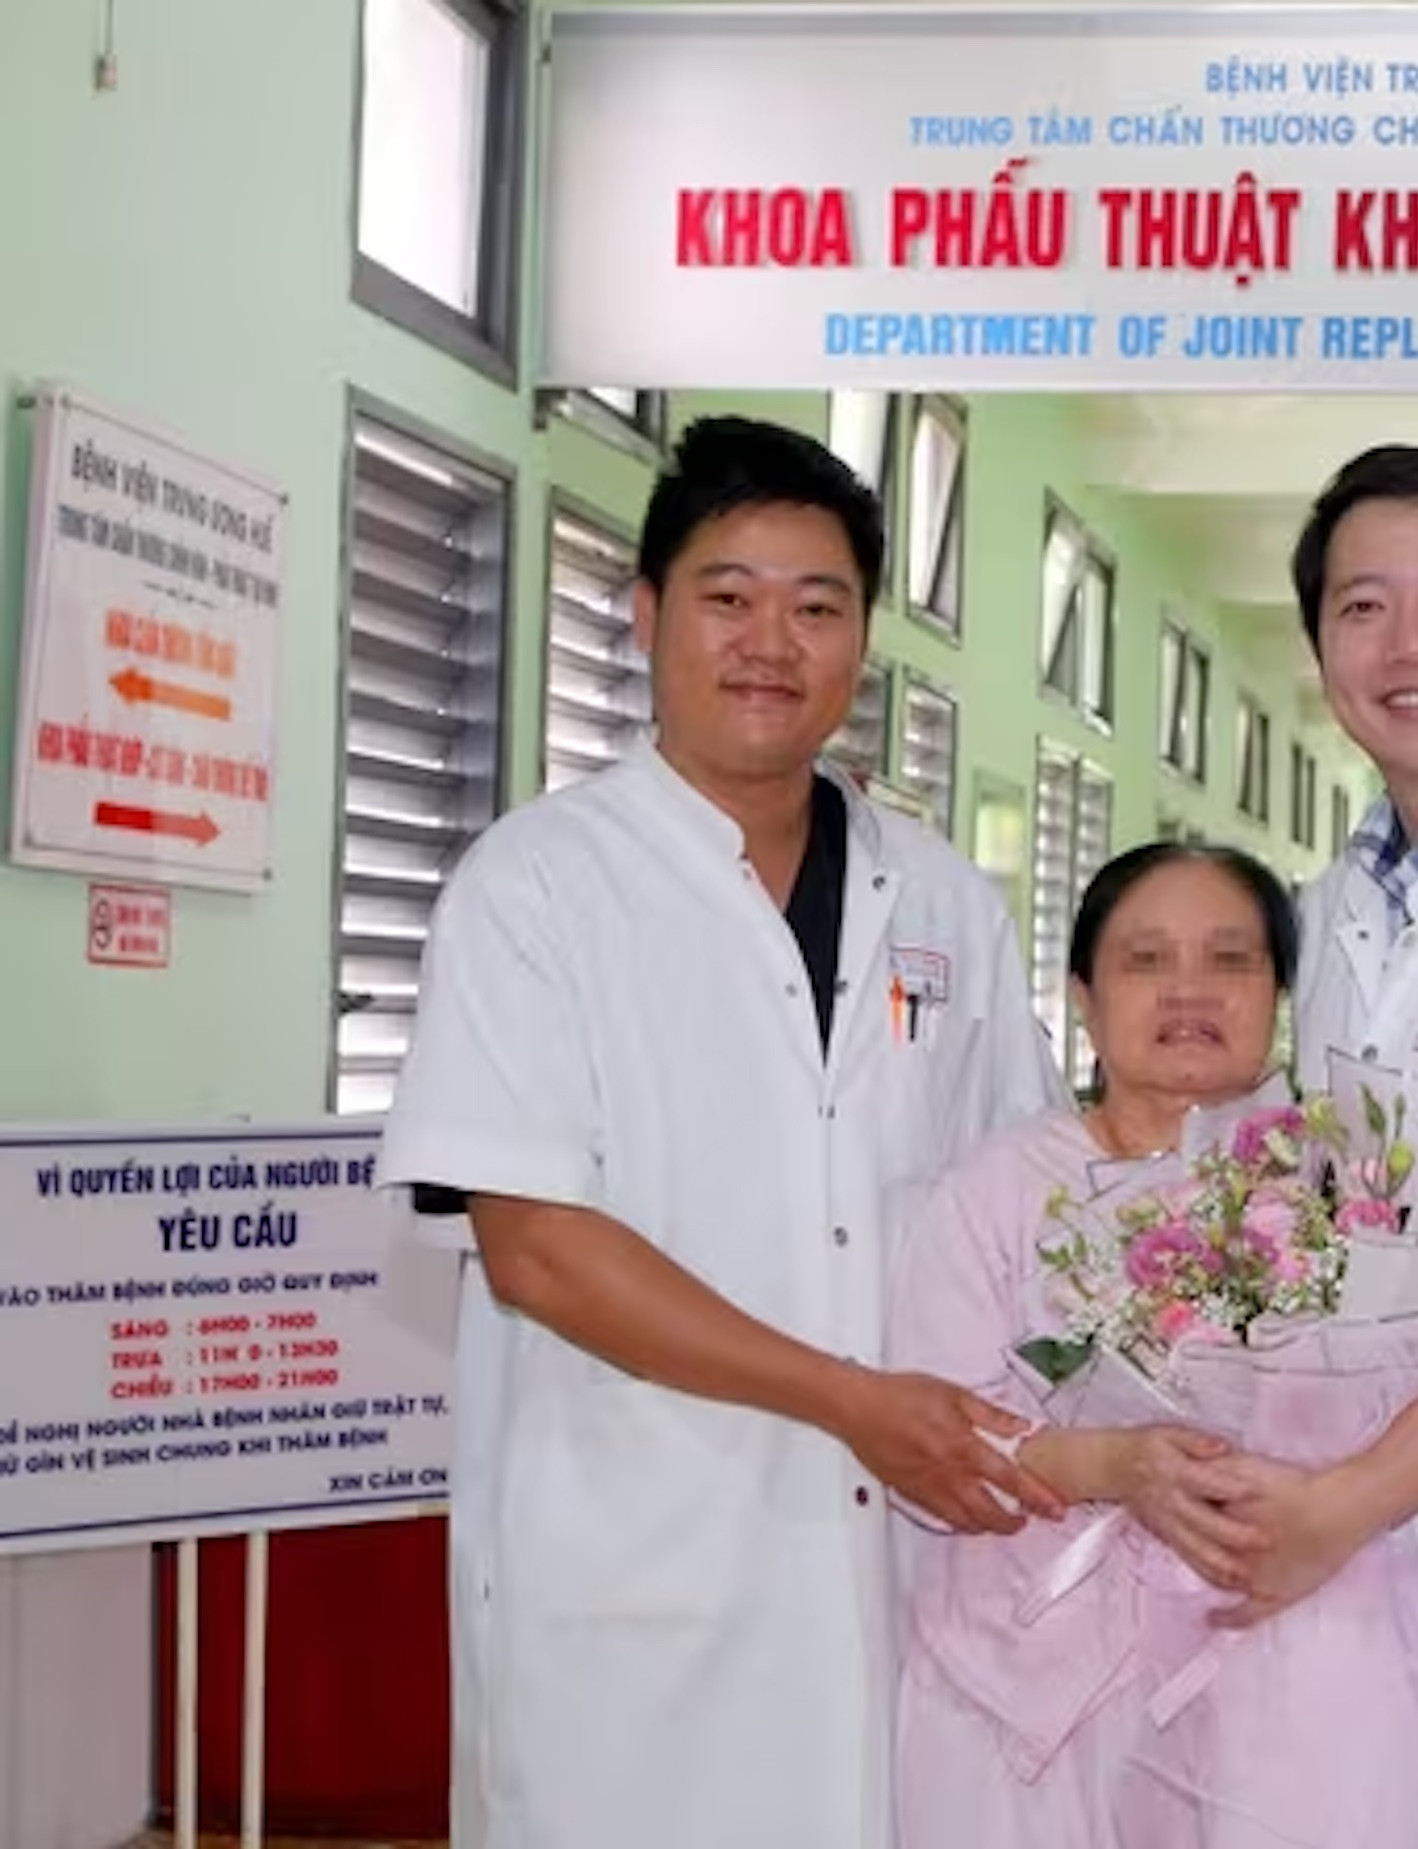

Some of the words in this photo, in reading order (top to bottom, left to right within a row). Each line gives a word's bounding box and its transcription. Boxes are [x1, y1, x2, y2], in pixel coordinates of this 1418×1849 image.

[1205, 56, 1288, 97] BỆNH
[1302, 56, 1374, 98] VIỆN
[910, 115, 1012, 145] TRUNG
[1108, 103, 1203, 145] CHẤN
[1221, 112, 1355, 145] THƯƠNG
[676, 188, 853, 268] KHOA
[891, 157, 1066, 268] PHẪU
[1098, 171, 1300, 288] THUẬT
[825, 313, 1095, 355] DEPARTMENT
[1118, 315, 1168, 357] OF
[1183, 316, 1303, 358] JOINT
[37, 1162, 60, 1197] VÌ
[162, 1162, 200, 1198] LỢI
[209, 1154, 257, 1190] CỦA
[267, 1156, 339, 1188] NGƯỜI
[347, 1152, 376, 1190] BỆ
[159, 1206, 221, 1252] YÊU
[46, 1281, 105, 1304] THĂM
[113, 1277, 166, 1304] BỆNH
[283, 1273, 324, 1291] QUY
[330, 1271, 379, 1296] ĐỊNH
[111, 1318, 169, 1340] SÁNG
[112, 1351, 162, 1369] TRƯA
[213, 1406, 263, 1428] BỆNH
[103, 1448, 150, 1468] SINH
[156, 1440, 231, 1462] CHUNG
[238, 1437, 271, 1456] KHI
[278, 1431, 331, 1453] THĂM
[338, 1427, 388, 1450] BỆNH
[330, 1474, 362, 1493] XIN
